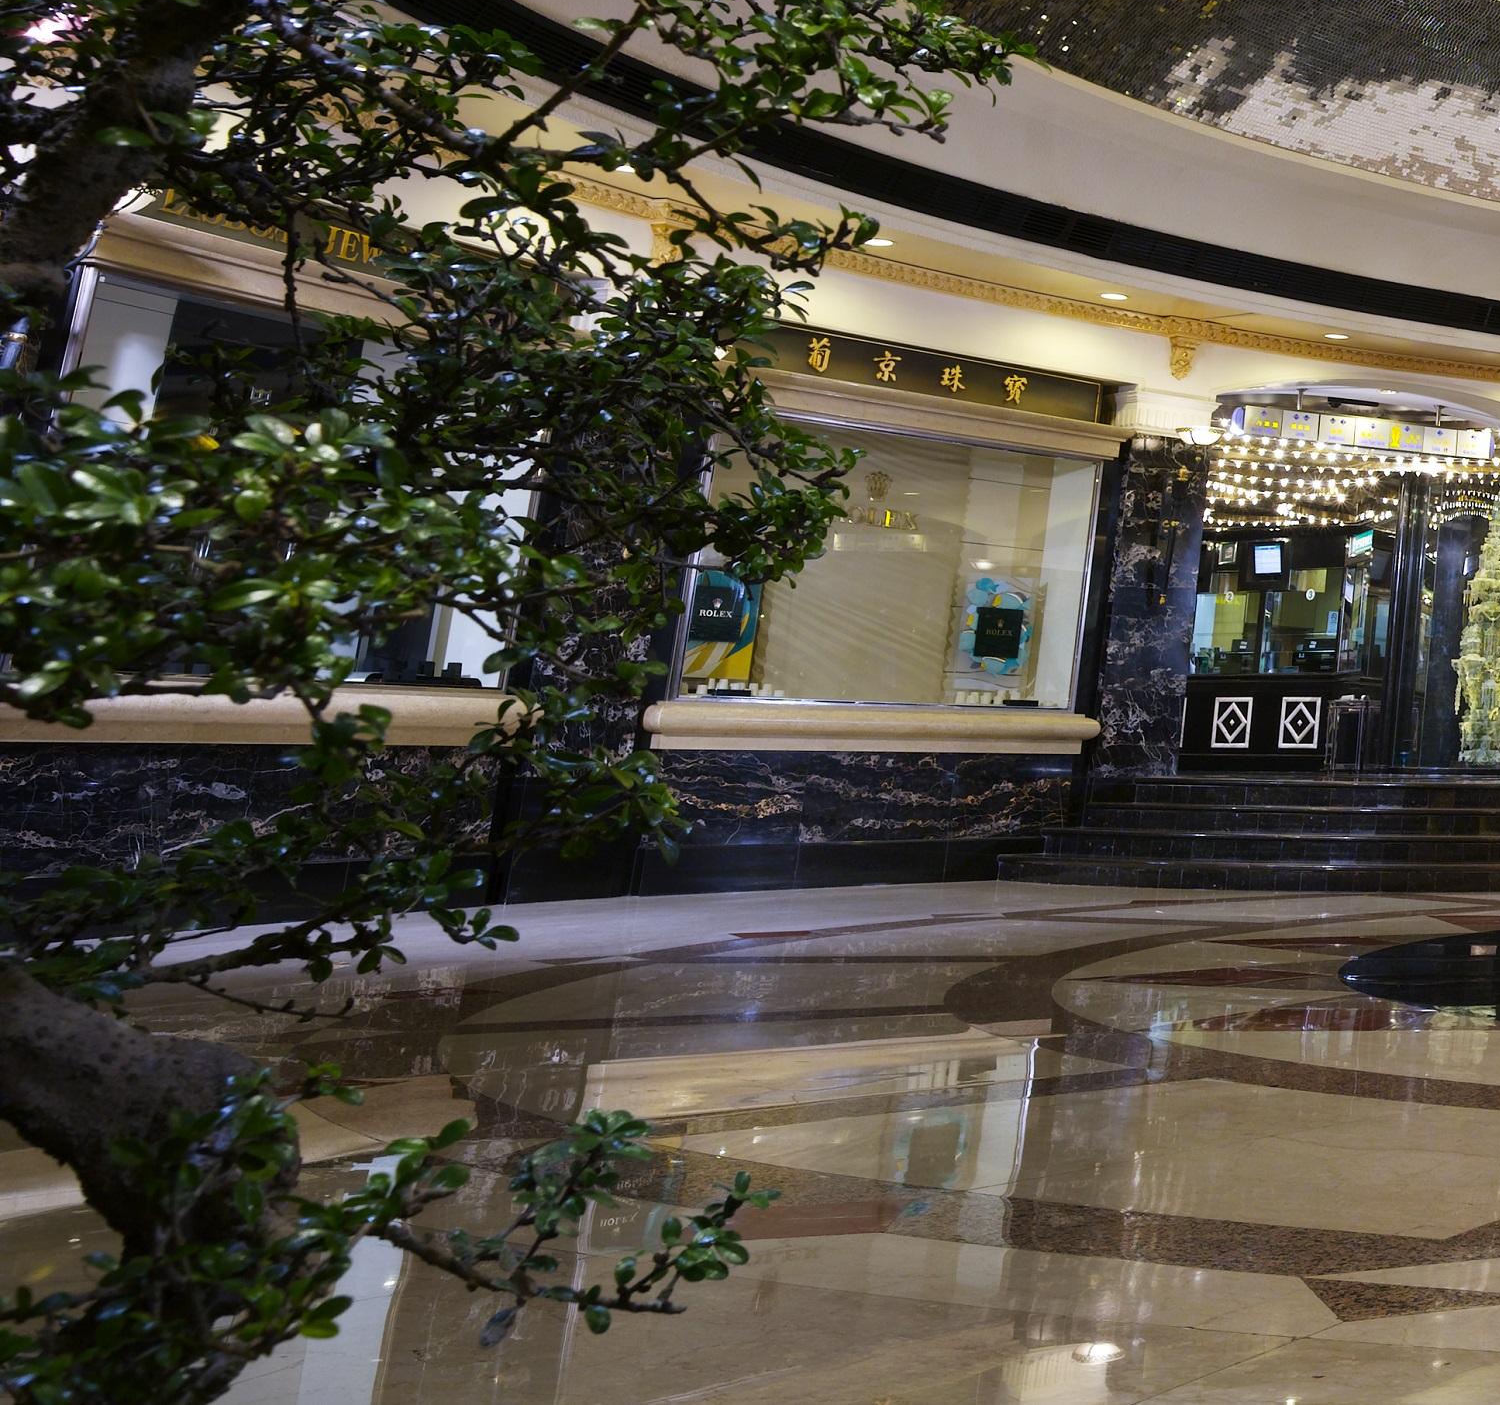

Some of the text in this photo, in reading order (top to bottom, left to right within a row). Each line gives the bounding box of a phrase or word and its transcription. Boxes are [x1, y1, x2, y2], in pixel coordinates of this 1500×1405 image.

[807, 337, 1027, 405] 葡京珠寶
[841, 506, 918, 531] OLEX
[699, 609, 733, 618] ROLEX
